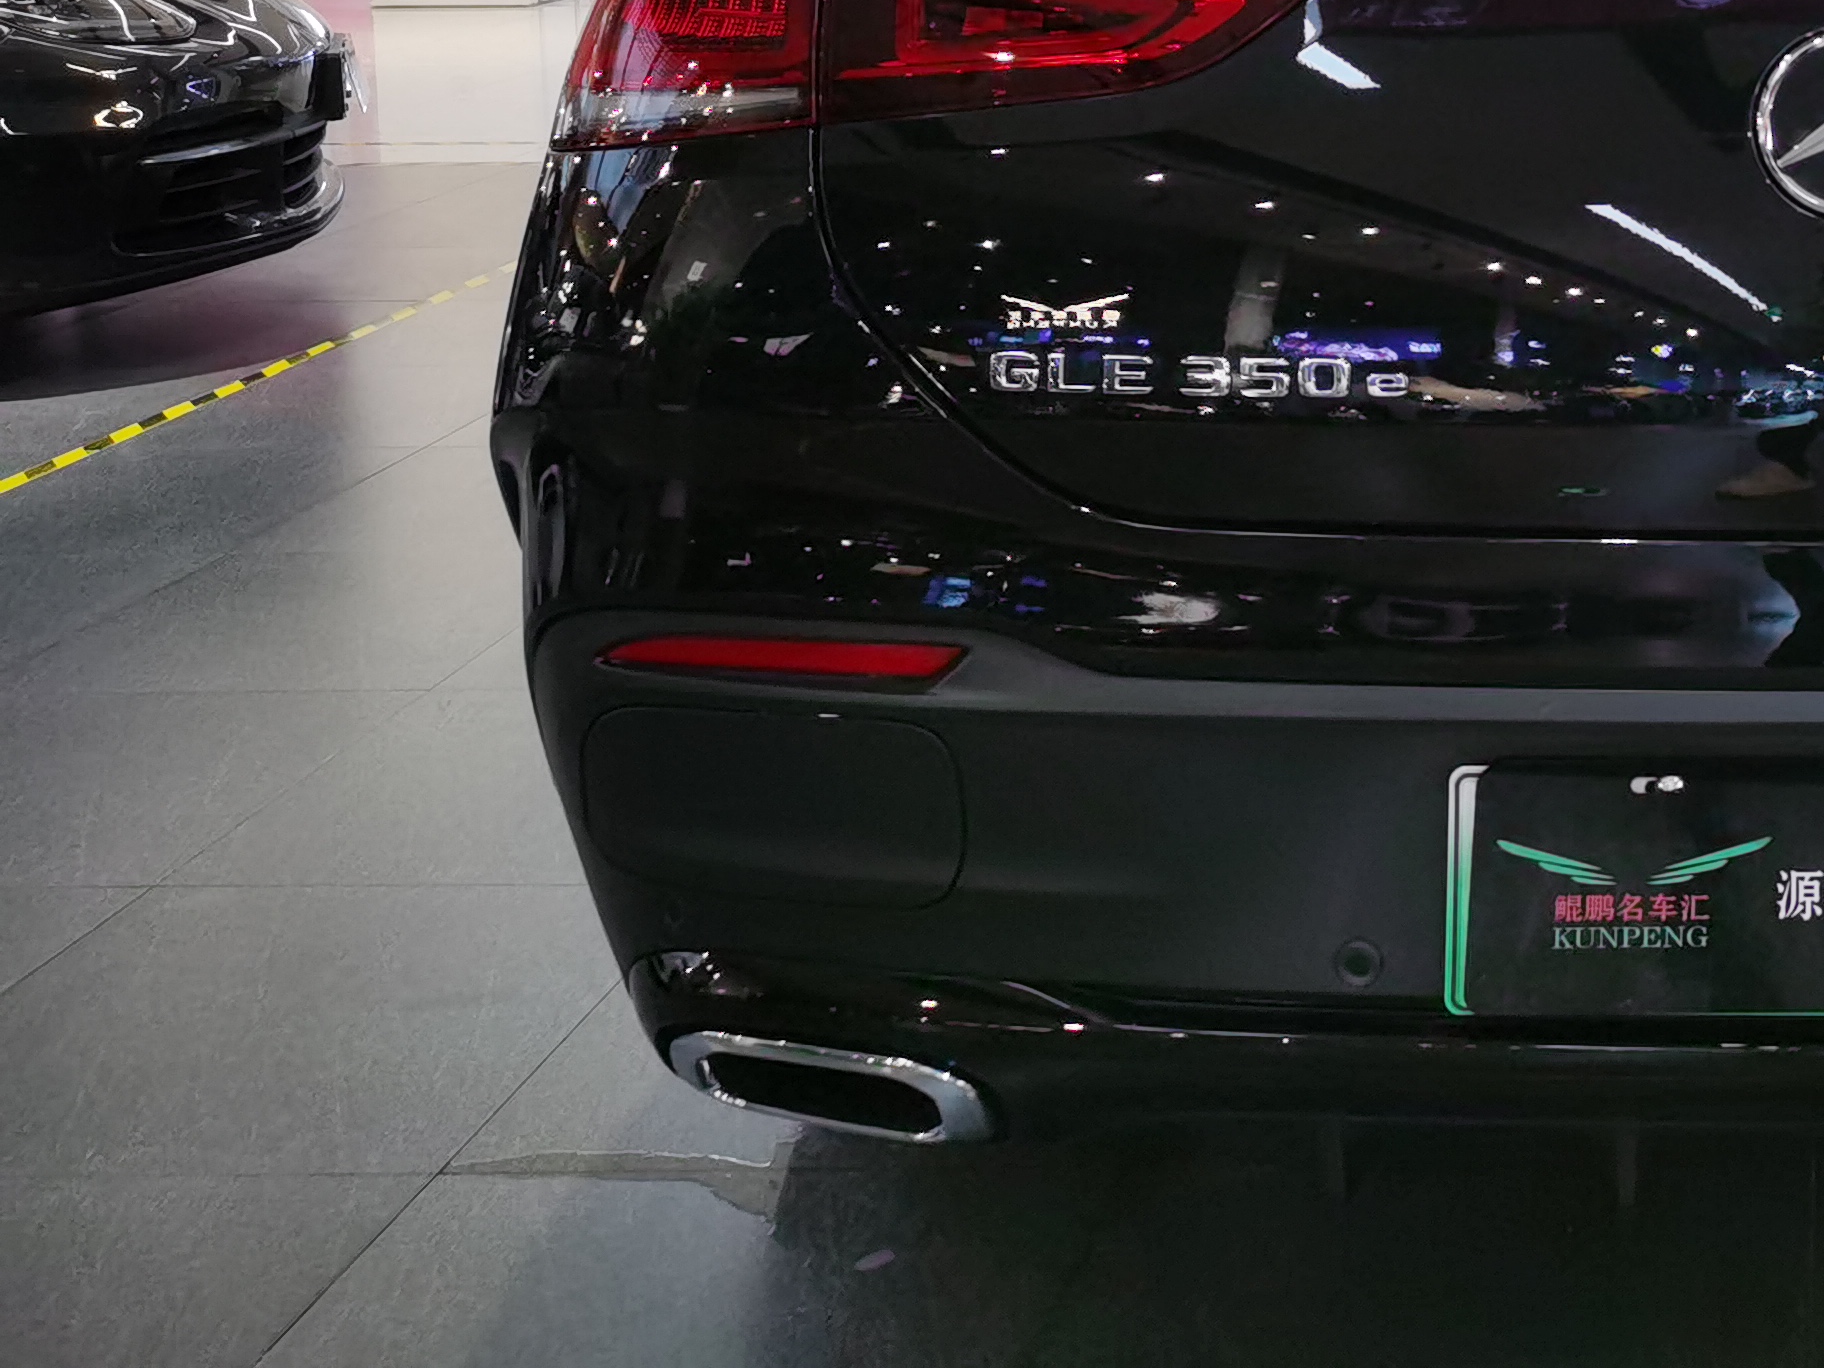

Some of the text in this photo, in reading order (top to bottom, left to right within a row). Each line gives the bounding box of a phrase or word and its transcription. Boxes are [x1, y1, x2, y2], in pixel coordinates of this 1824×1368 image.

[989, 349, 1155, 396] GLE
[1553, 892, 1711, 923] 鲲鹏名车汇
[1551, 925, 1710, 950] KUNPENG
